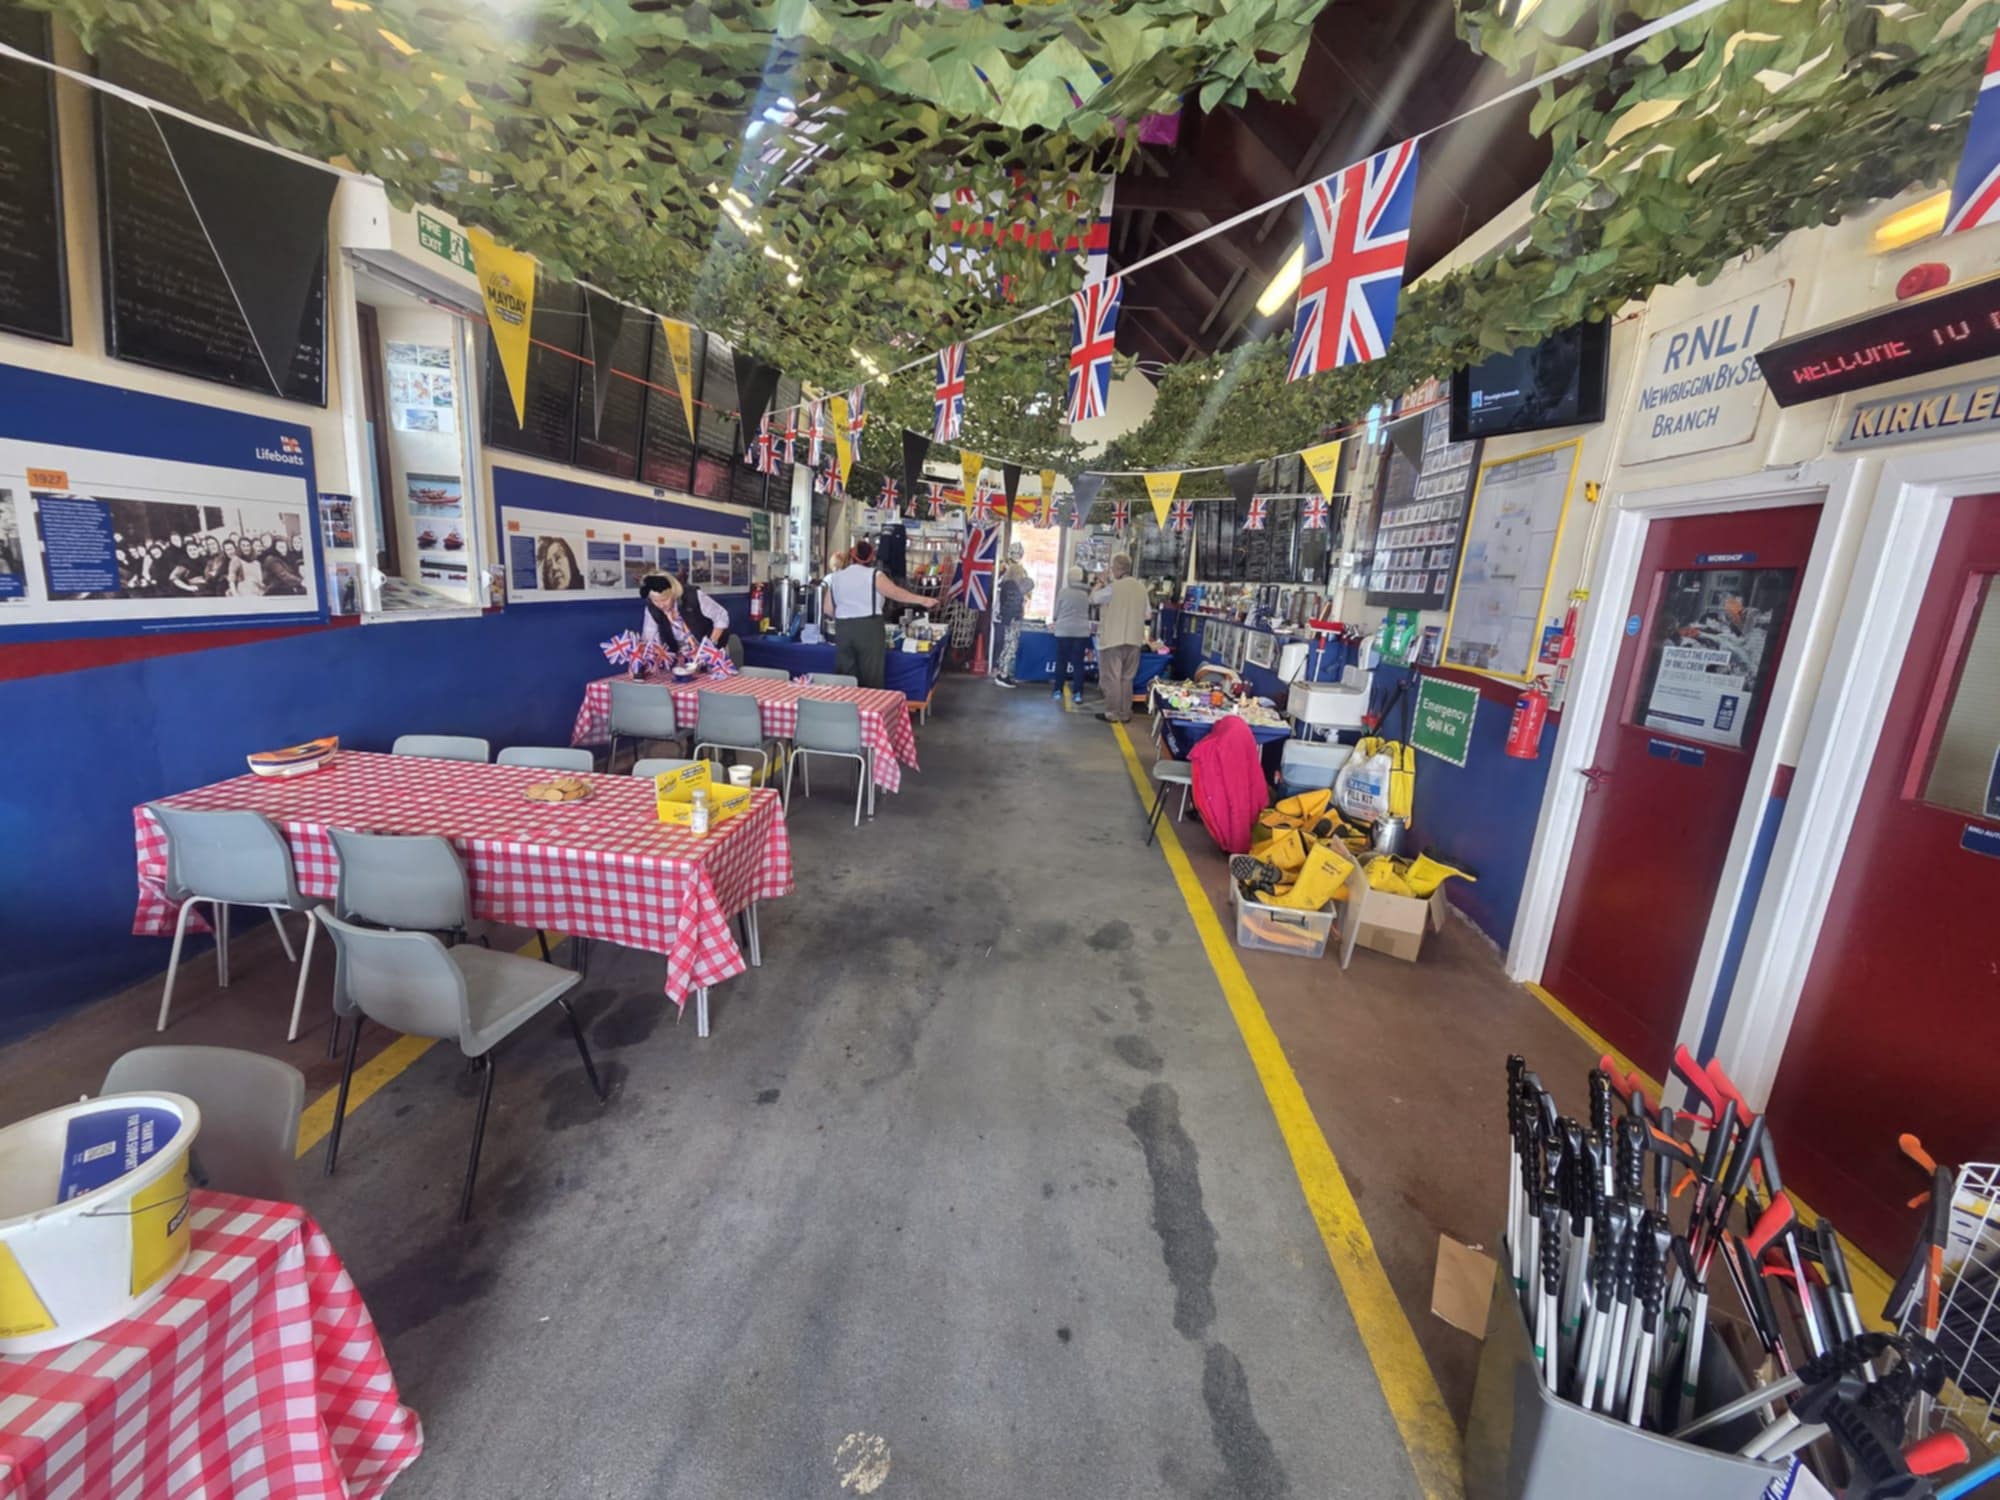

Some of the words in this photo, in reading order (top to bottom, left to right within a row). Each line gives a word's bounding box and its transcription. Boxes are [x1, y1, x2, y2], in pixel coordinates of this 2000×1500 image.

[421, 215, 441, 238] FIRE
[487, 284, 528, 316] MAYDAY
[1663, 303, 1760, 375] RNLI
[1734, 354, 1763, 387] SE
[1651, 405, 1720, 439] BRANCH
[1850, 384, 2000, 441] KIRKLE
[255, 446, 305, 466] Lifeboats
[1423, 697, 1469, 724] Emergency
[1425, 715, 1444, 732] Spill
[1443, 721, 1457, 737] Kit
